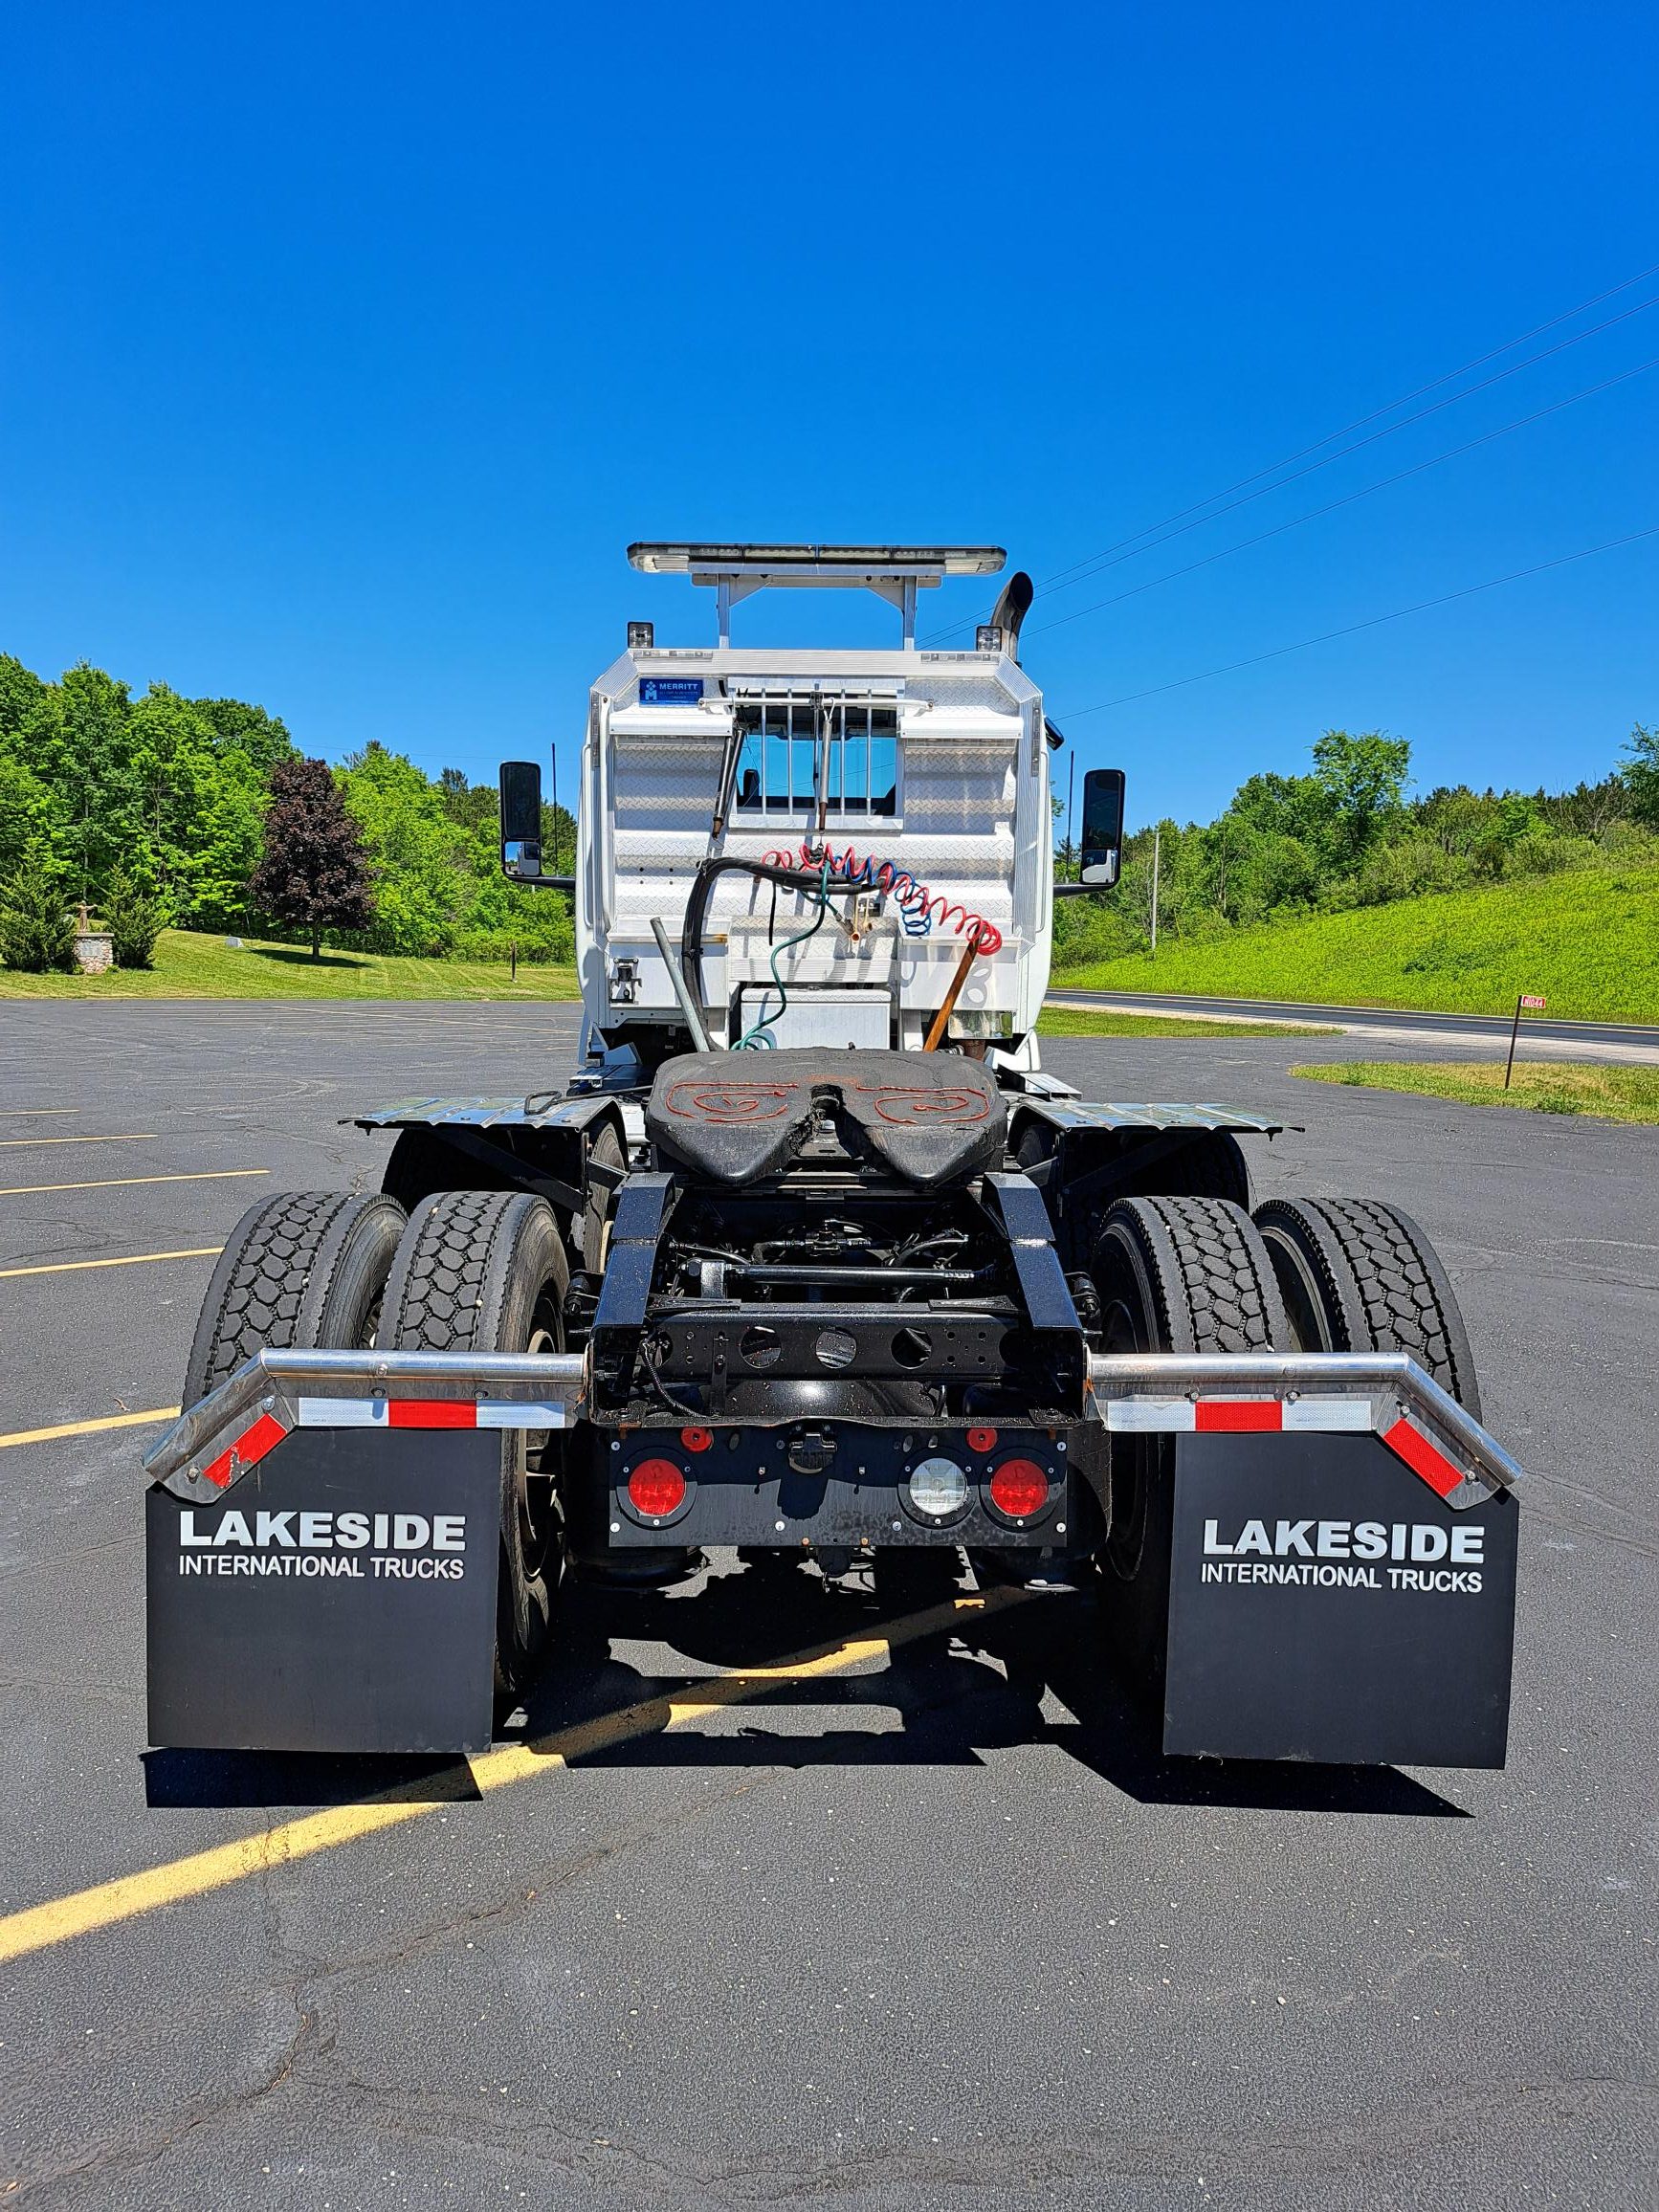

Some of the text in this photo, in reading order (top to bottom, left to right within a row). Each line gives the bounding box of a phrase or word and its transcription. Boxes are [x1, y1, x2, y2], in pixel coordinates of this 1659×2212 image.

[179, 1510, 466, 1551] LAKESIDE
[1203, 1519, 1485, 1564] LAKESIDE
[179, 1555, 465, 1580] INTERNATIONAL TRUCKS
[1201, 1562, 1483, 1593] INTERNATIONAL TRUCKS
